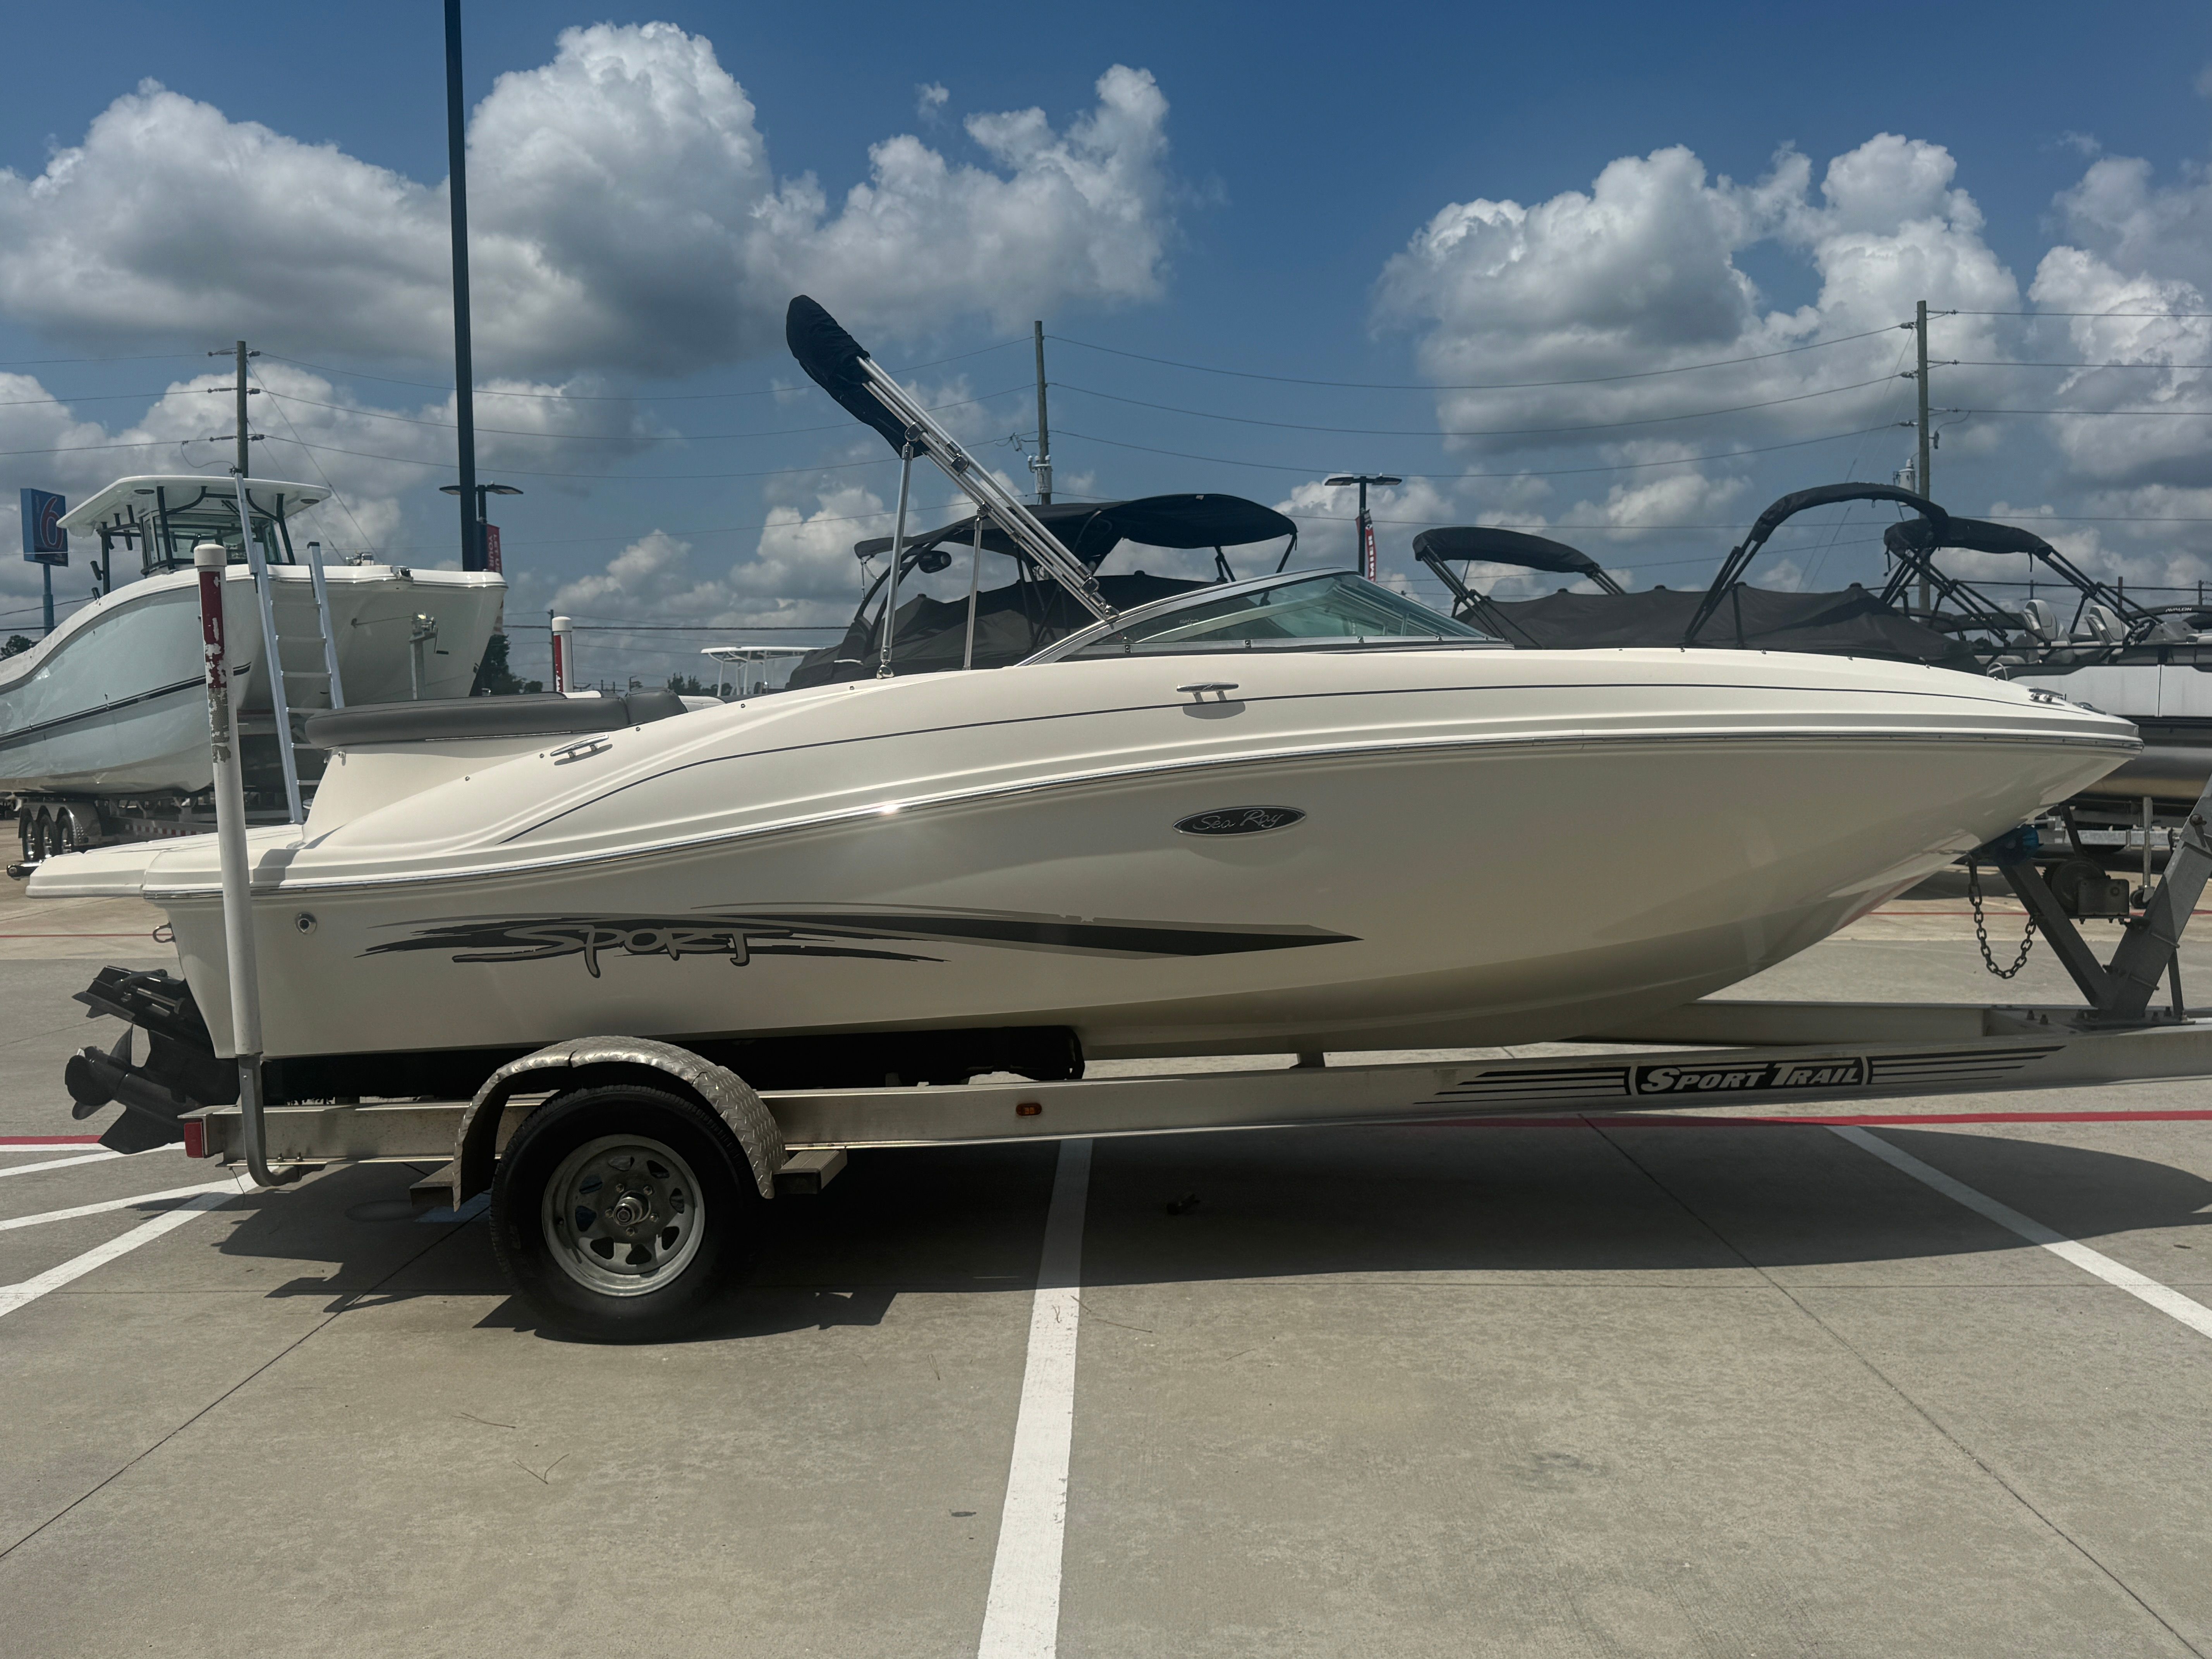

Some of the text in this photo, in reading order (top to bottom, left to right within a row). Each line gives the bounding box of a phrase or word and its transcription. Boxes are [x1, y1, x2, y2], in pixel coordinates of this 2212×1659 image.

[40, 496, 64, 550] 6
[1192, 809, 1284, 830] Sea Ray
[1640, 1060, 1859, 1092] SPORT TRAIL
